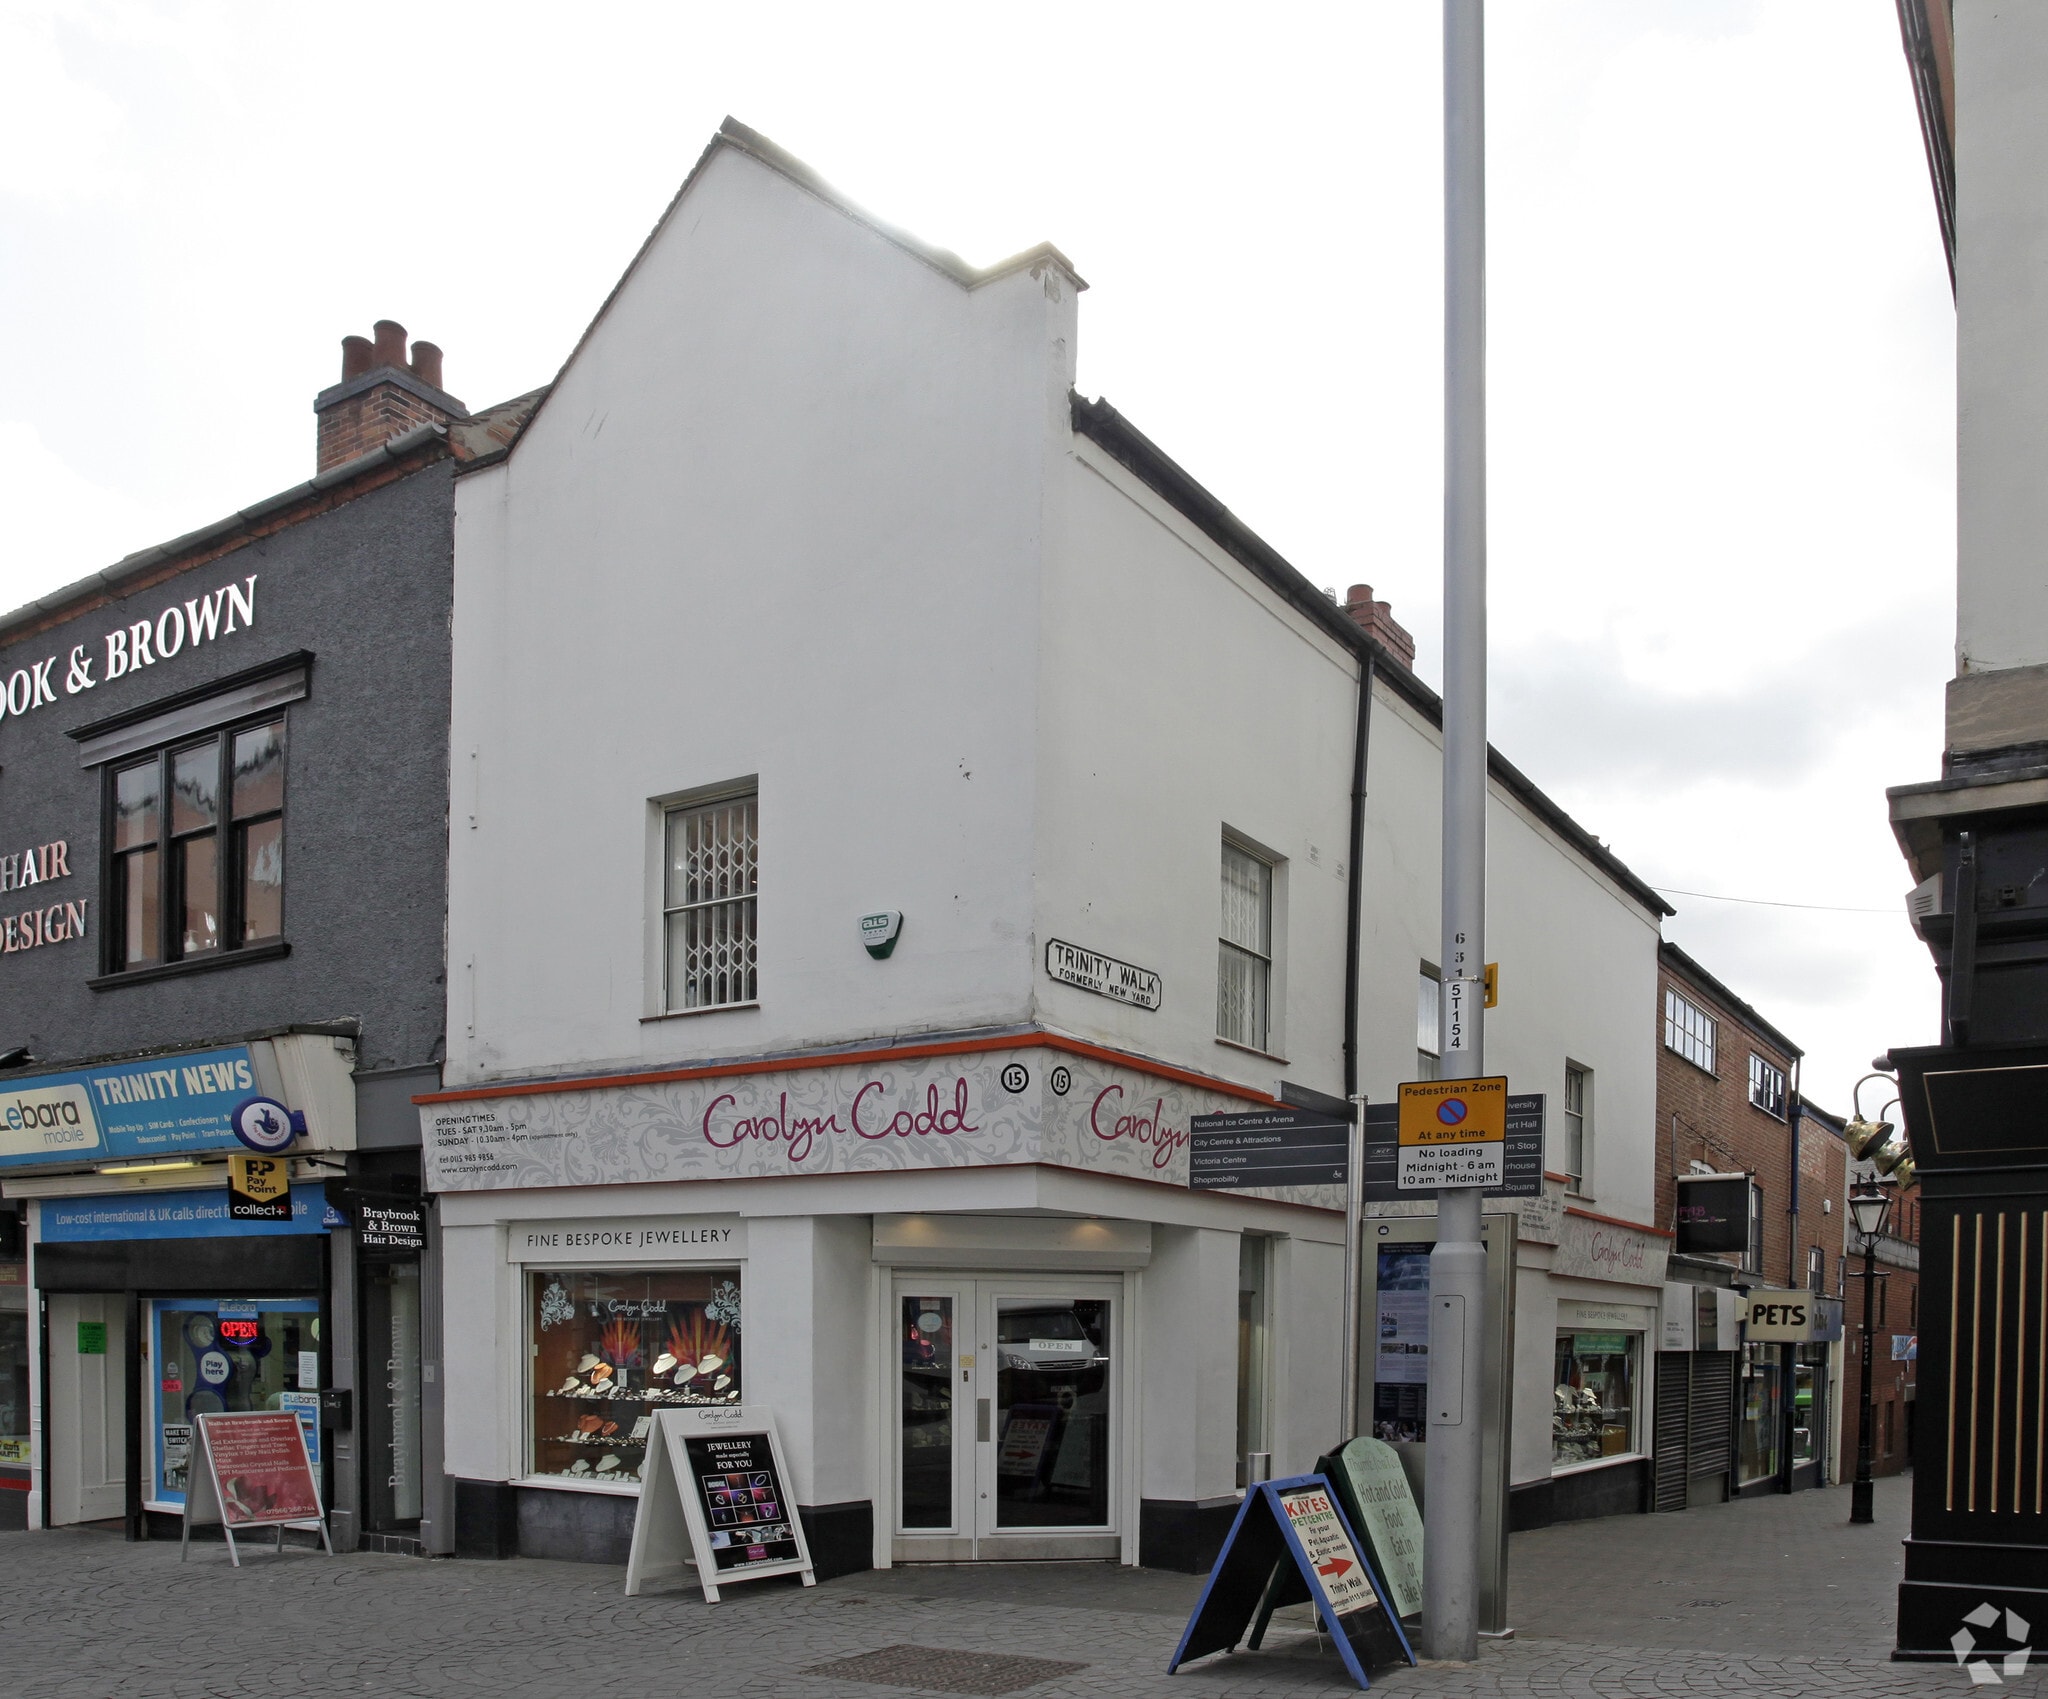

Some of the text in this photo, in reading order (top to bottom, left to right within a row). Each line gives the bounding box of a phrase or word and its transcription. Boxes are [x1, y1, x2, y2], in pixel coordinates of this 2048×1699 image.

[67, 644, 96, 694] &
[105, 574, 257, 681] BROWN
[0, 899, 87, 952] ESIGN
[1056, 944, 1155, 994] TRINITY WALK
[1059, 968, 1151, 1005] FORMERLY NEW YARD
[1451, 984, 1461, 1048] 5T154
[94, 1059, 253, 1105] TRINITY NEWS
[1008, 1071, 1022, 1086] 15
[1056, 1073, 1067, 1089] 15
[1404, 1083, 1501, 1096] Pedestrian Zone
[1507, 1101, 1537, 1110] iversity
[108, 1125, 126, 1134] Mobile
[127, 1124, 135, 1133] Top
[136, 1123, 144, 1132] Up
[148, 1121, 158, 1129] SIM
[158, 1120, 175, 1128] Cards
[179, 1116, 219, 1127] Confectionery
[435, 1113, 496, 1127] OPENING TIMES
[703, 1077, 979, 1162] Carolyn Codd
[1194, 1119, 1224, 1128] National
[1238, 1117, 1263, 1126] Centre
[1265, 1116, 1271, 1124] &
[1272, 1115, 1295, 1123] Arena
[1520, 1120, 1537, 1128] Hall
[437, 1128, 456, 1137] TUES
[462, 1126, 477, 1135] SAT
[510, 1123, 527, 1131] 5pm
[1091, 1084, 1190, 1169] Carolyn
[44, 1127, 85, 1144] mobile
[171, 1133, 181, 1142] Pay
[182, 1131, 196, 1139] Point
[201, 1129, 215, 1138] Tram
[437, 1137, 469, 1147] SUNDAY
[476, 1135, 505, 1144] 10.30am
[511, 1134, 528, 1142] 4pm
[1418, 1129, 1486, 1140] At any time
[1194, 1135, 1281, 1148] City Centre & Attractions
[1517, 1141, 1537, 1151] Stop
[440, 1155, 449, 1163] tel
[464, 1154, 476, 1162] 985
[1419, 1148, 1483, 1158] No loading
[1194, 1156, 1247, 1166] Victoria Centre
[1406, 1161, 1495, 1173] Midnight 6 am
[441, 1162, 518, 1174] www.carolyncodd.com
[247, 1176, 266, 1186] Pay
[1193, 1175, 1240, 1184] Shopmobility
[1403, 1172, 1498, 1185] 10 am Midnight
[248, 1184, 277, 1193] Point
[1505, 1183, 1535, 1192] Square
[56, 1205, 222, 1225] Low-cost international & UK calls direct
[234, 1204, 284, 1216] collect+
[362, 1207, 421, 1221] Braybrook
[367, 1220, 417, 1233] & Brown
[363, 1234, 423, 1247] Hair Design
[527, 1229, 732, 1248] FINE BESPOKE JEWELLERY
[1752, 1304, 1806, 1326] PETS
[221, 1321, 258, 1338] OPEN
[1038, 1341, 1073, 1350] OPEN
[205, 1366, 224, 1376] here
[206, 1360, 223, 1370] Play
[290, 1394, 317, 1404] Lebara
[387, 1315, 405, 1488] Braybrook & Brown
[698, 1409, 743, 1421] Carolyn Codd
[707, 1441, 751, 1452] JEWELLERY
[717, 1460, 753, 1469] FOR YOU
[1358, 1479, 1407, 1504] Hot and Cold
[1285, 1497, 1329, 1517] KAYES
[1292, 1511, 1334, 1527] PET CENTRE
[1382, 1506, 1404, 1529] Food
[1317, 1524, 1330, 1534] your
[1309, 1543, 1347, 1558] & Exotic needs
[1390, 1534, 1415, 1557] Eat in
[1407, 1562, 1417, 1578] or
[1329, 1581, 1348, 1594] Trinity
[1348, 1577, 1363, 1588] Walk
[1398, 1583, 1420, 1605] Take
